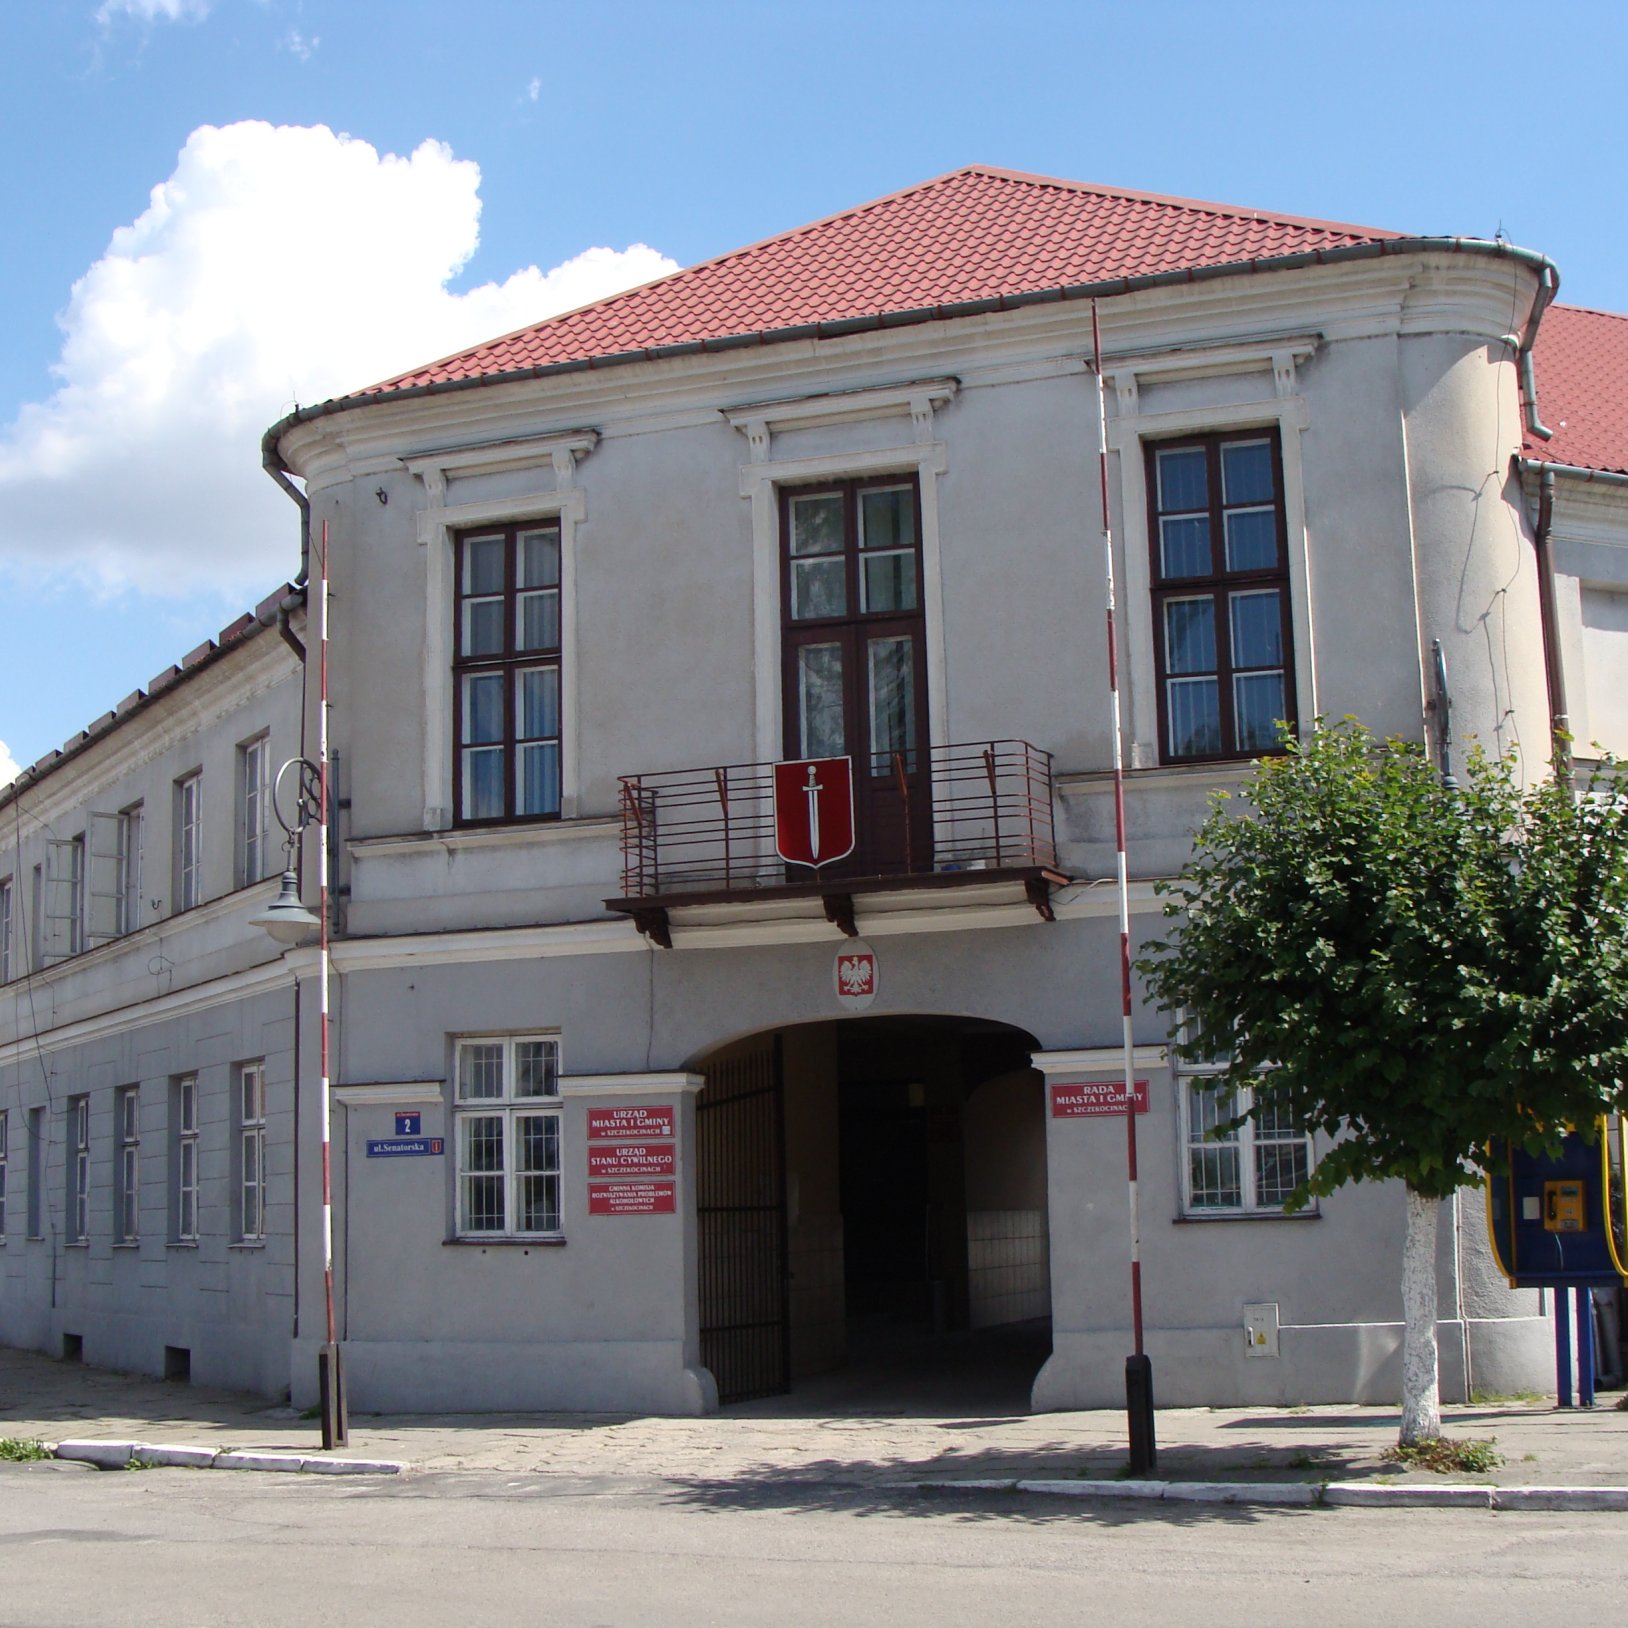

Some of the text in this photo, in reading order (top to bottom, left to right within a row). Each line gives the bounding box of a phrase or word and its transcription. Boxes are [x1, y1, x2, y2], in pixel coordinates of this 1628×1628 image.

[1084, 1086, 1114, 1094] RADA
[1056, 1096, 1096, 1104] MIASTA
[1074, 1104, 1128, 1112] SZCZEKOCINAC
[613, 1110, 647, 1119] URZĄD
[404, 1118, 411, 1132] 2
[592, 1120, 628, 1128] MIASTA
[637, 1118, 670, 1126] GMINY
[616, 1148, 646, 1156] URZĄD
[591, 1156, 672, 1166] STANU CYWILNEGO
